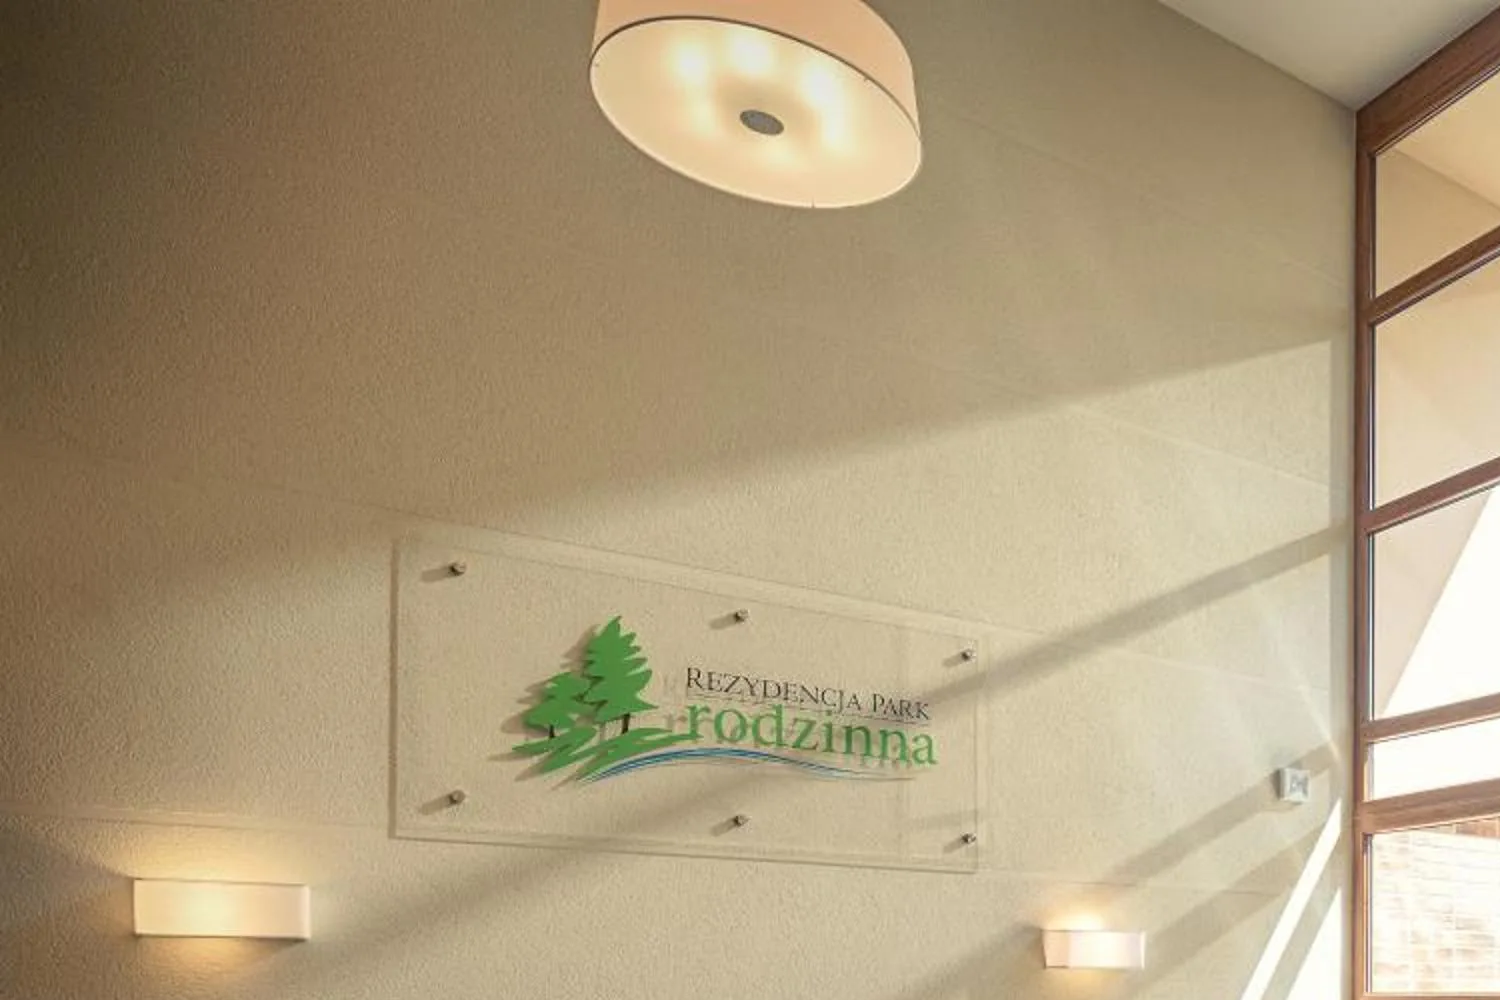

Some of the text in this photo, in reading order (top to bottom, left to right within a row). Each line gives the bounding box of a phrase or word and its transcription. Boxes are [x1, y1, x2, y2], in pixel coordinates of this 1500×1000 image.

[686, 666, 930, 720] REZYDENCJA PARK
[687, 703, 937, 765] rodzinna
